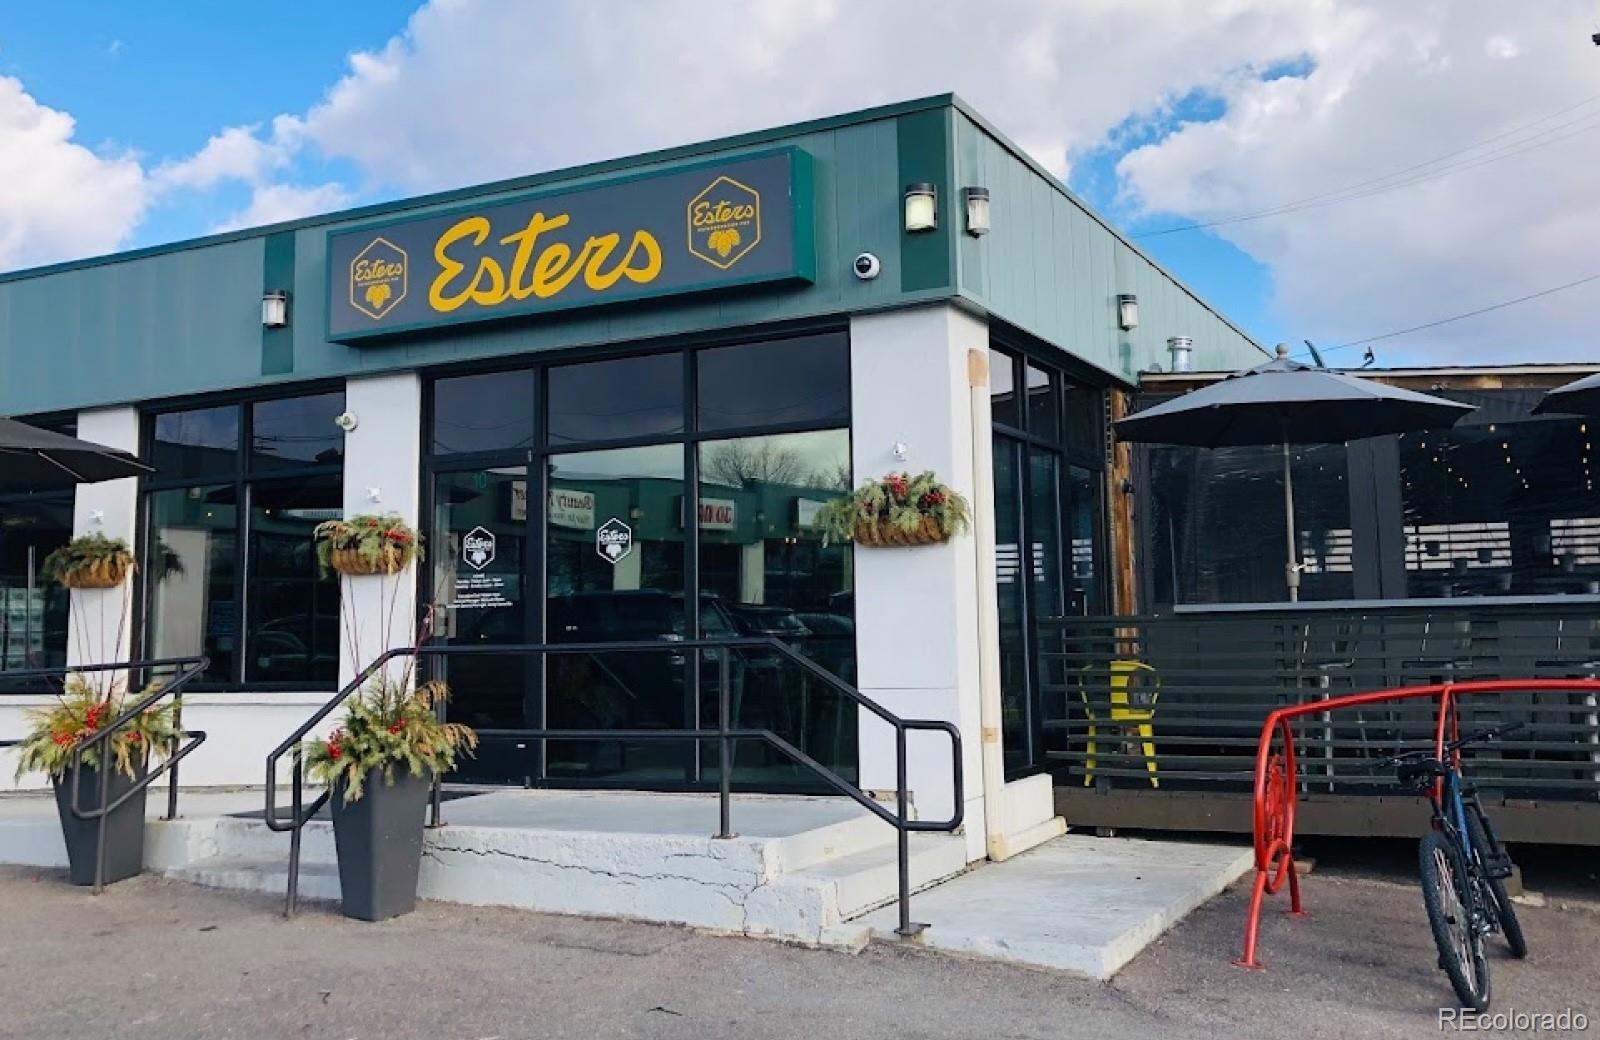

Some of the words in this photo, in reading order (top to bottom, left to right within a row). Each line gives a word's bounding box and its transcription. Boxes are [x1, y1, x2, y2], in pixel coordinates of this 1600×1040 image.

[693, 200, 754, 226] Esters
[355, 259, 403, 281] Esters
[429, 212, 662, 313] Esters
